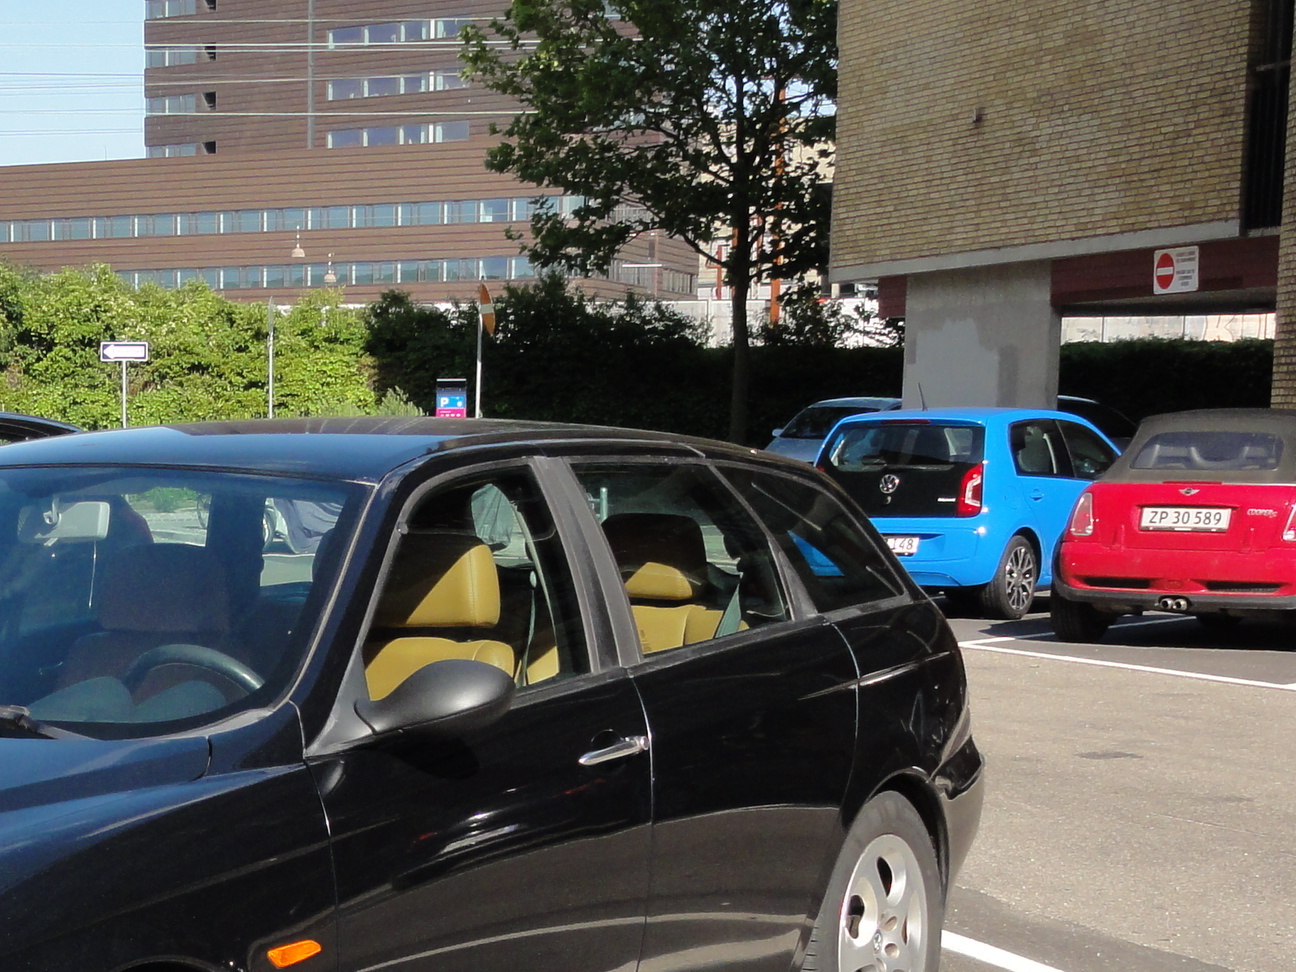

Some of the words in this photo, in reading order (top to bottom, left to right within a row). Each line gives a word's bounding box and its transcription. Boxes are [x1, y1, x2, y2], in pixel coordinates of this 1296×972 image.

[440, 397, 450, 408] P
[1148, 510, 1169, 525] ZP
[1171, 510, 1191, 526] 30
[1193, 510, 1222, 526] 589
